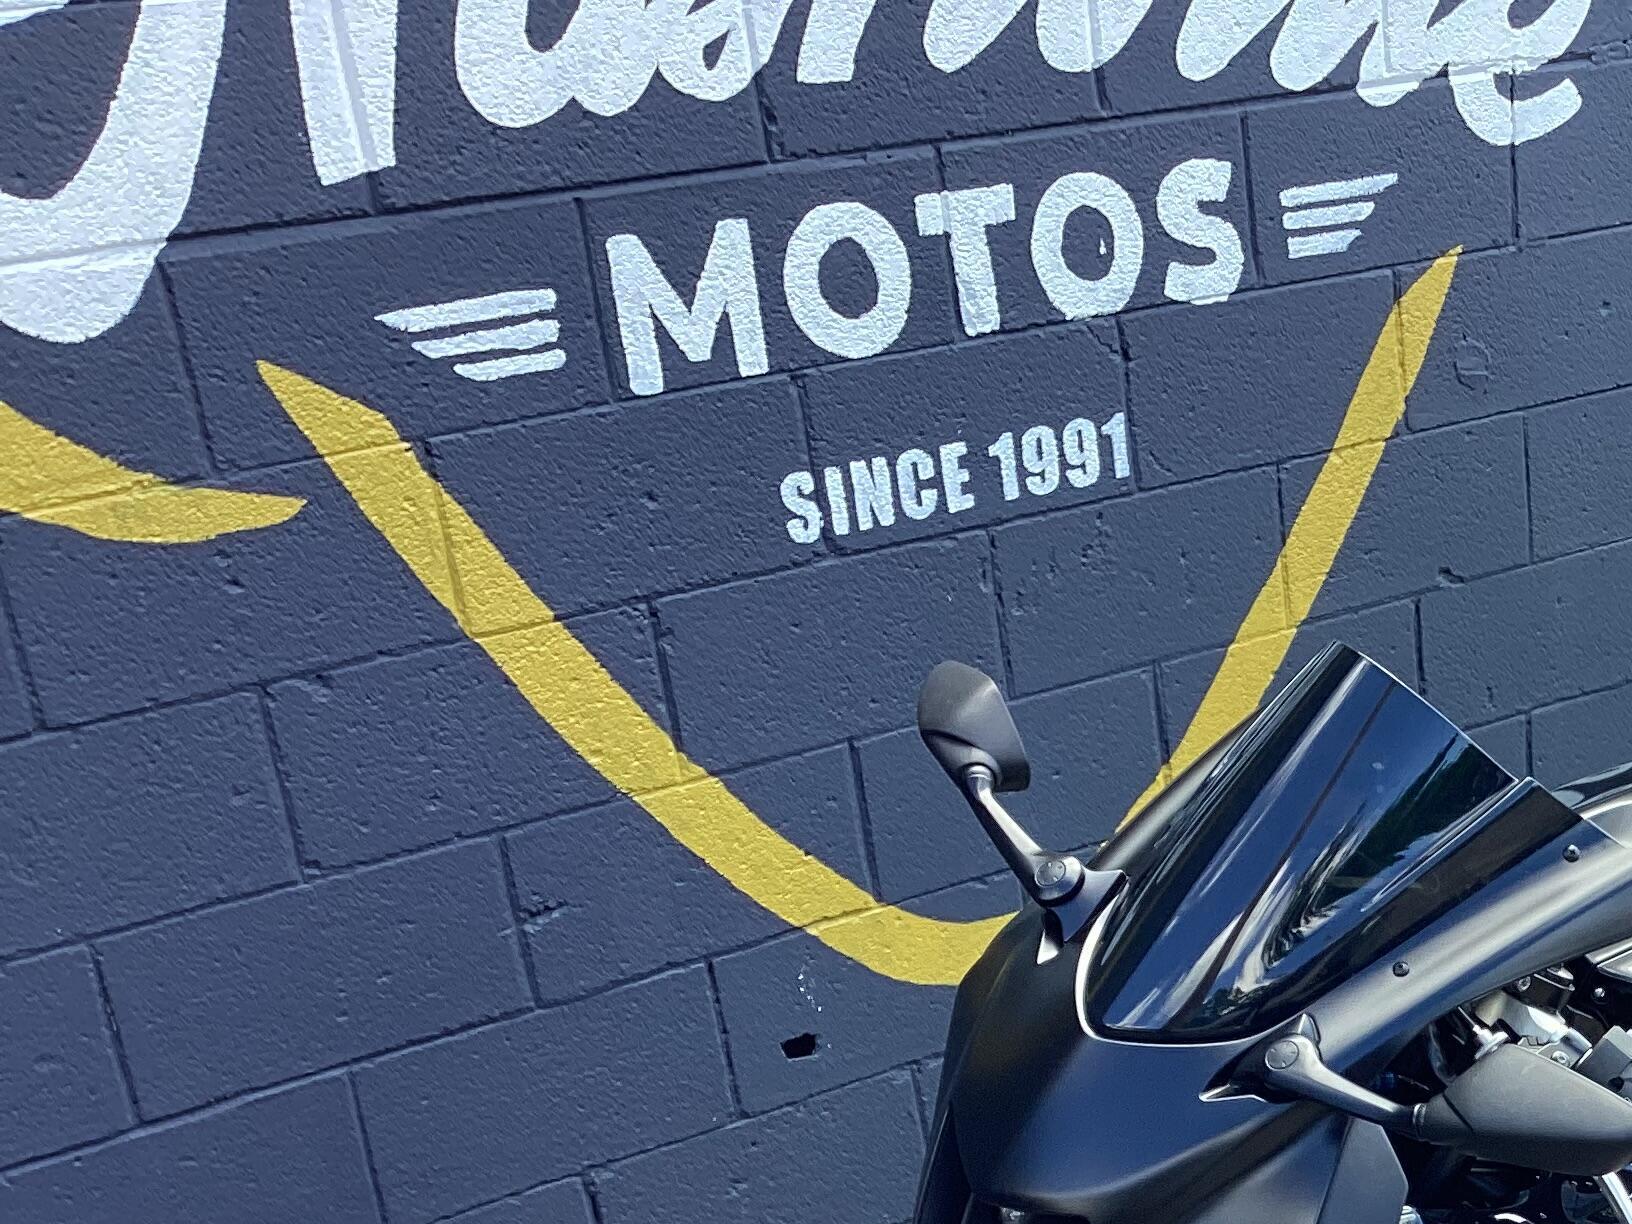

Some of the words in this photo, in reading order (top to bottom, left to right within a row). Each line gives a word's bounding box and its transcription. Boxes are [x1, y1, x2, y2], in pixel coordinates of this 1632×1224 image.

[604, 157, 1245, 396] MOTOS
[780, 441, 975, 544] SINCE
[988, 412, 1131, 501] 1991
